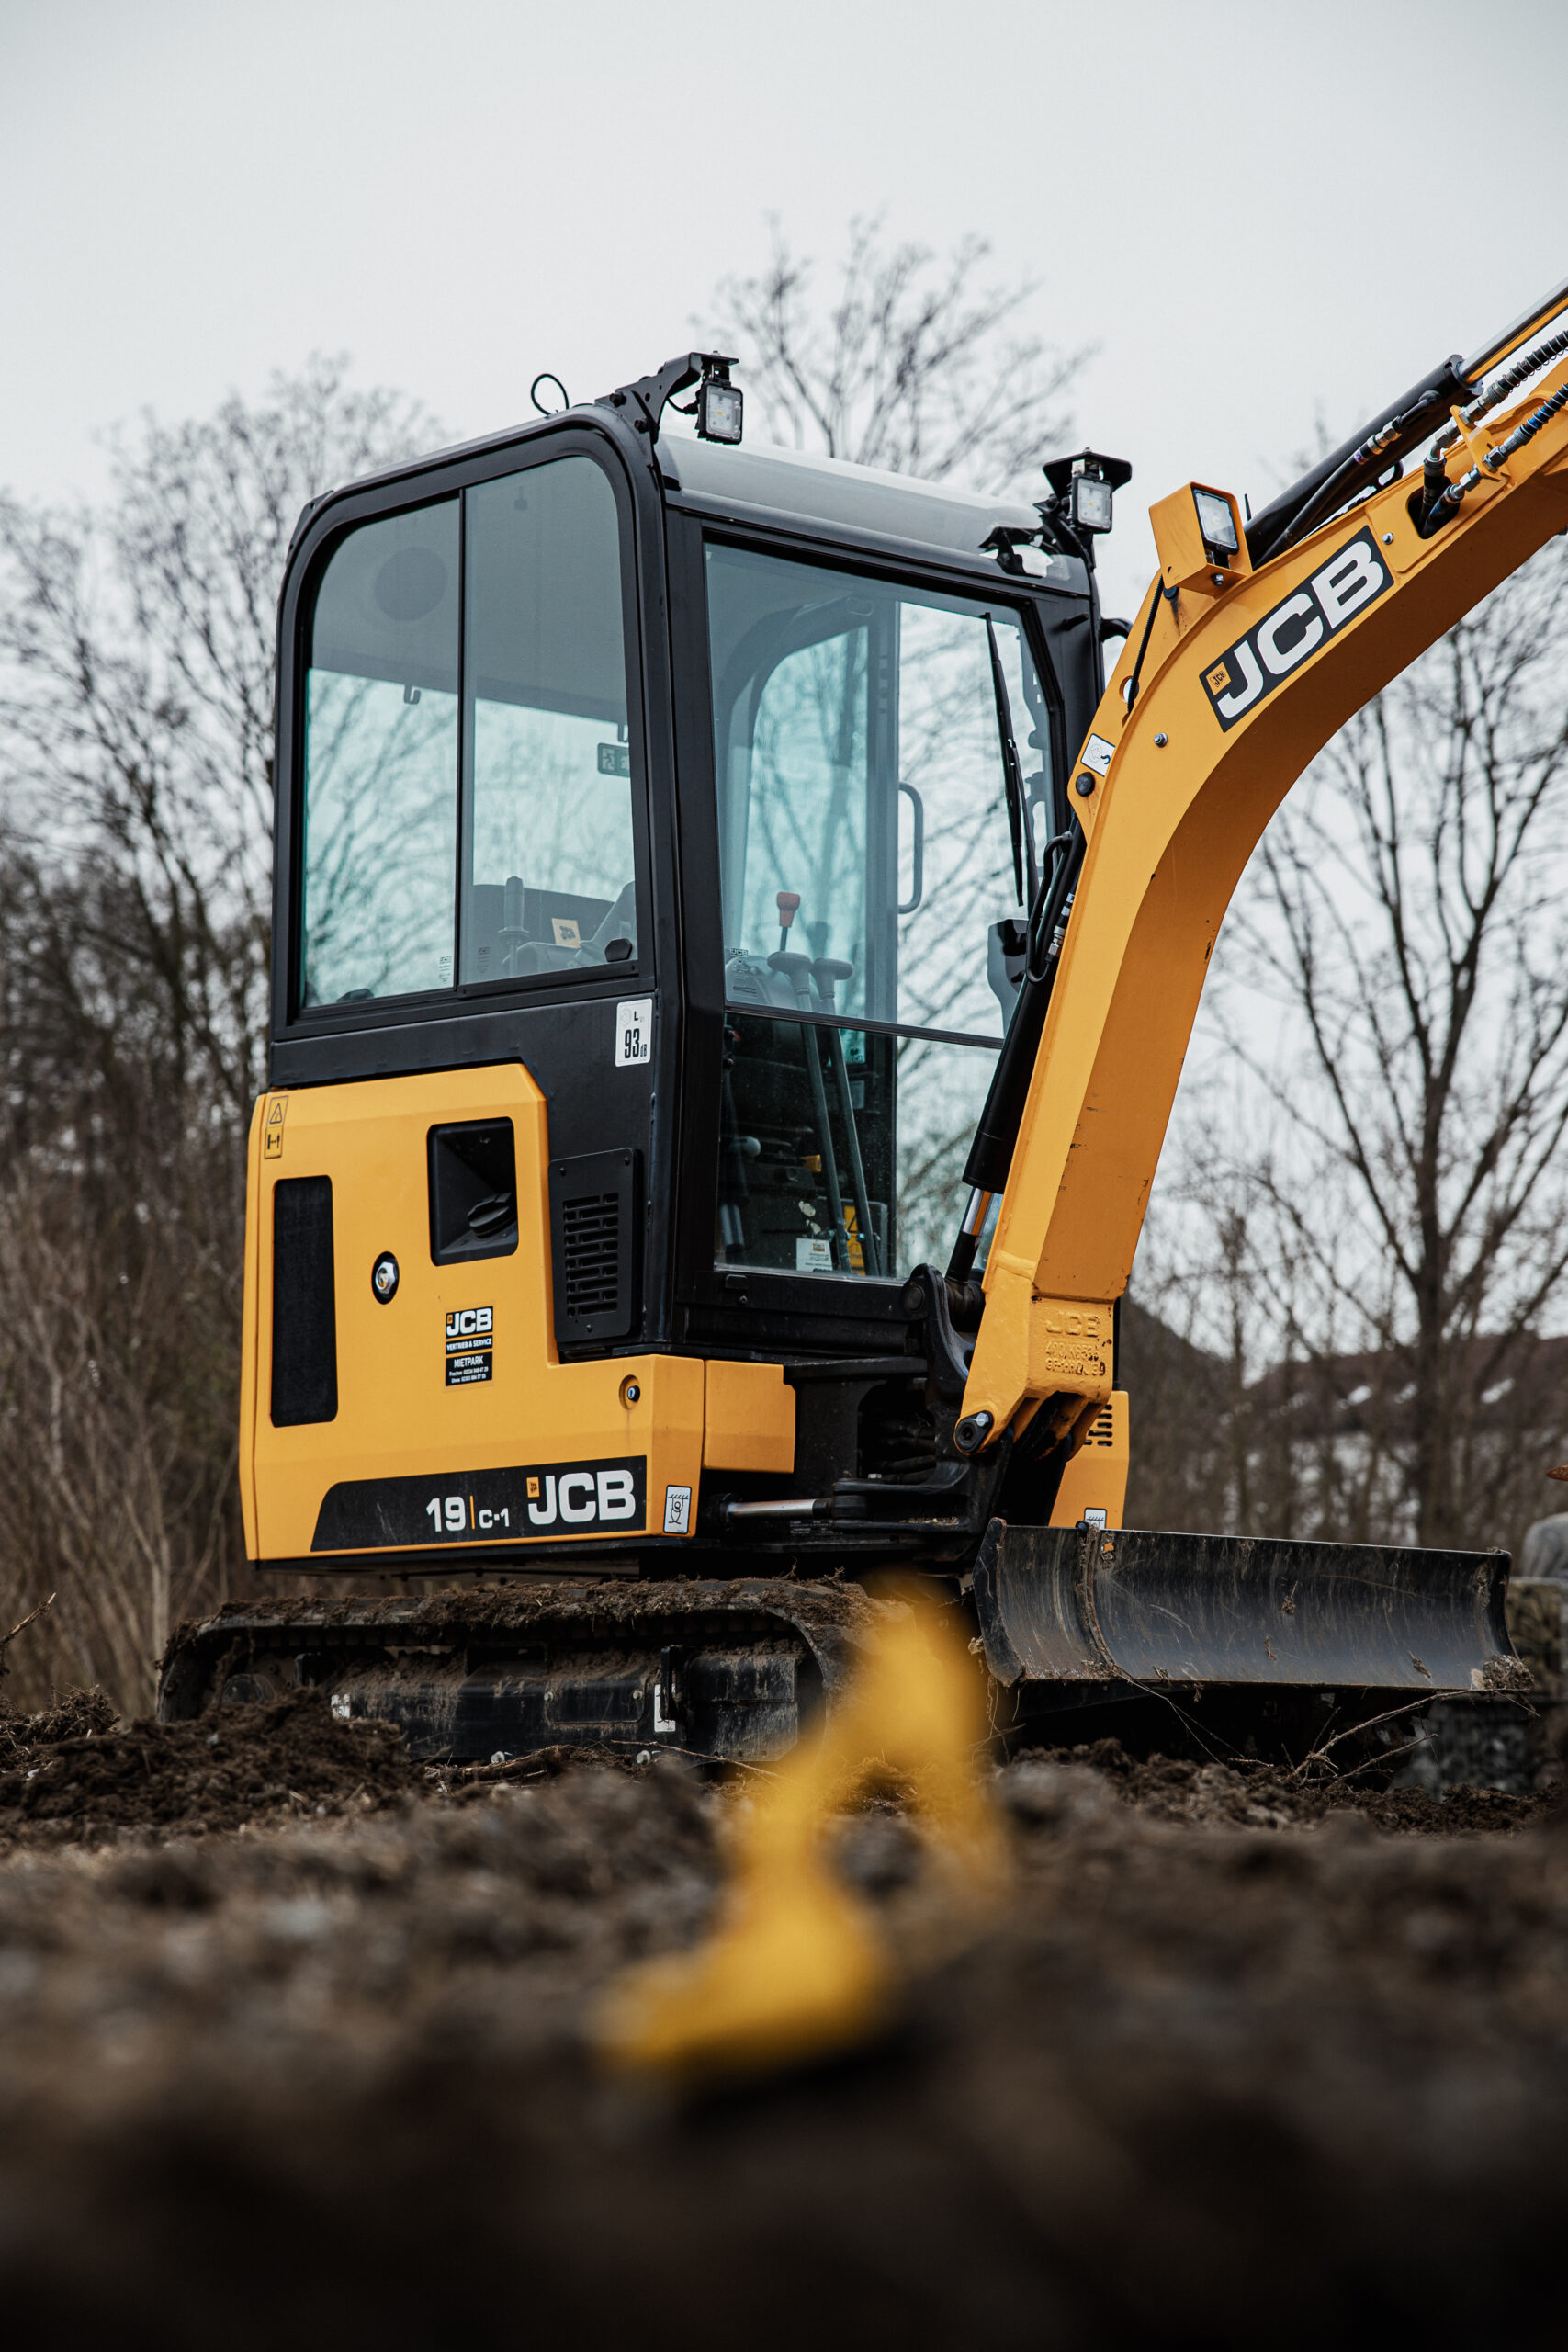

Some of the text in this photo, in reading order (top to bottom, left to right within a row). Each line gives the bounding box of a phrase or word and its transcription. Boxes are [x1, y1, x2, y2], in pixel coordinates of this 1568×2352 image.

[1217, 540, 1384, 718] JCB
[625, 1028, 640, 1059] 93
[446, 1308, 492, 1336] JCB
[1045, 1310, 1099, 1338] JCB
[446, 1341, 468, 1351] VERTRIEB
[473, 1338, 491, 1347] SERVICE
[454, 1355, 483, 1368] MIETPARK
[426, 1496, 466, 1532] 19
[527, 1469, 636, 1525] JCB
